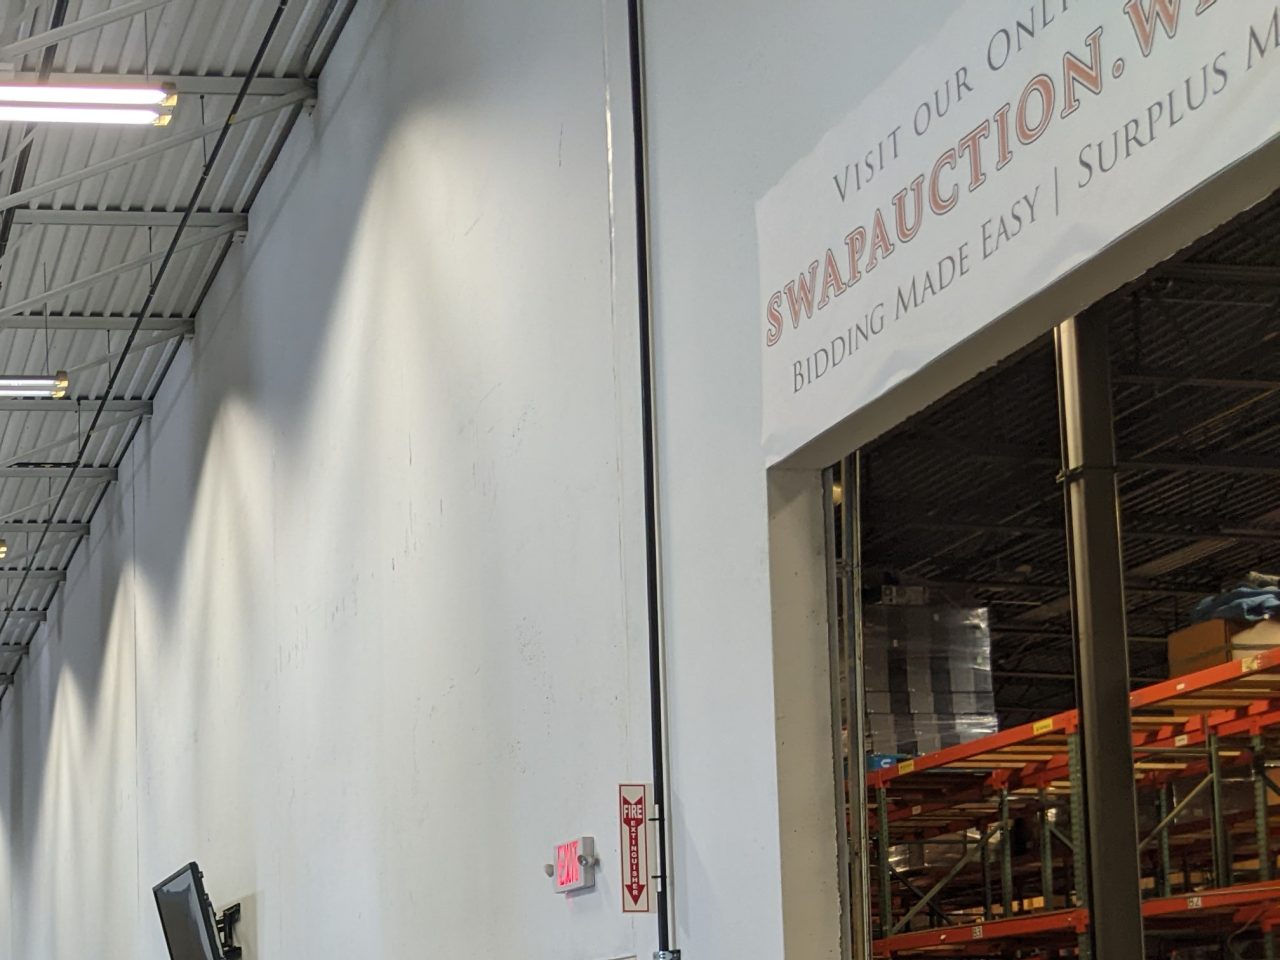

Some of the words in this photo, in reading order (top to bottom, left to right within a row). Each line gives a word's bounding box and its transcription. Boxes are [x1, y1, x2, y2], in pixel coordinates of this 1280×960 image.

[832, 126, 902, 203] VISIT
[913, 67, 974, 137] OUR
[792, 302, 886, 393] BIDDING
[894, 242, 970, 321] MADE
[981, 186, 1040, 260] EASY
[1077, 52, 1229, 189] SURPLUS
[623, 804, 643, 819] FIRE
[558, 841, 580, 886] EXIT
[630, 820, 639, 896] EXTINGUISHER
